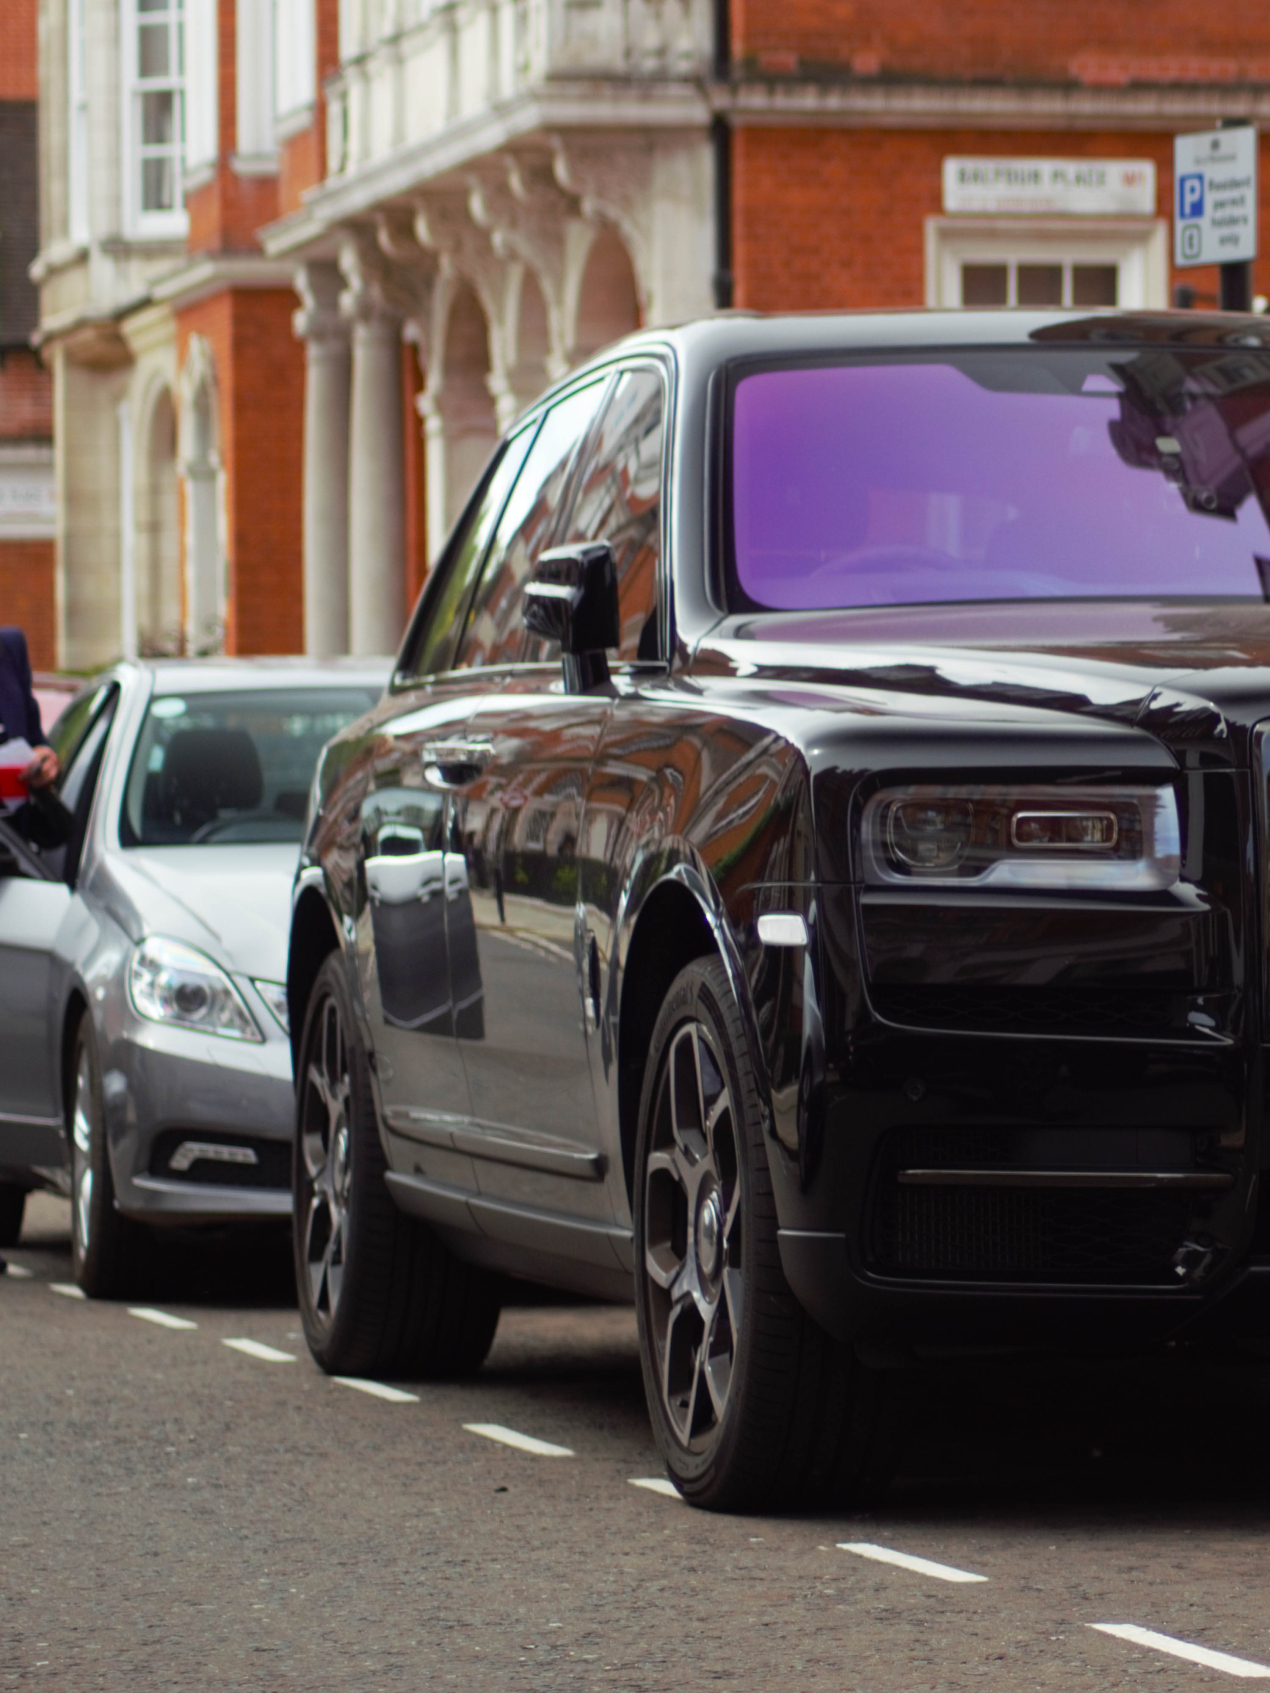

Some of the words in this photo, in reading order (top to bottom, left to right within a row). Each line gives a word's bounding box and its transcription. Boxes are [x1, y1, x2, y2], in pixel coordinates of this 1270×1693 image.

[958, 167, 1042, 185] BALFOUR
[1052, 168, 1106, 187] PLACE
[1184, 178, 1201, 215] P
[1213, 195, 1245, 211] permit
[1211, 214, 1248, 227] holders
[1219, 233, 1240, 247] only
